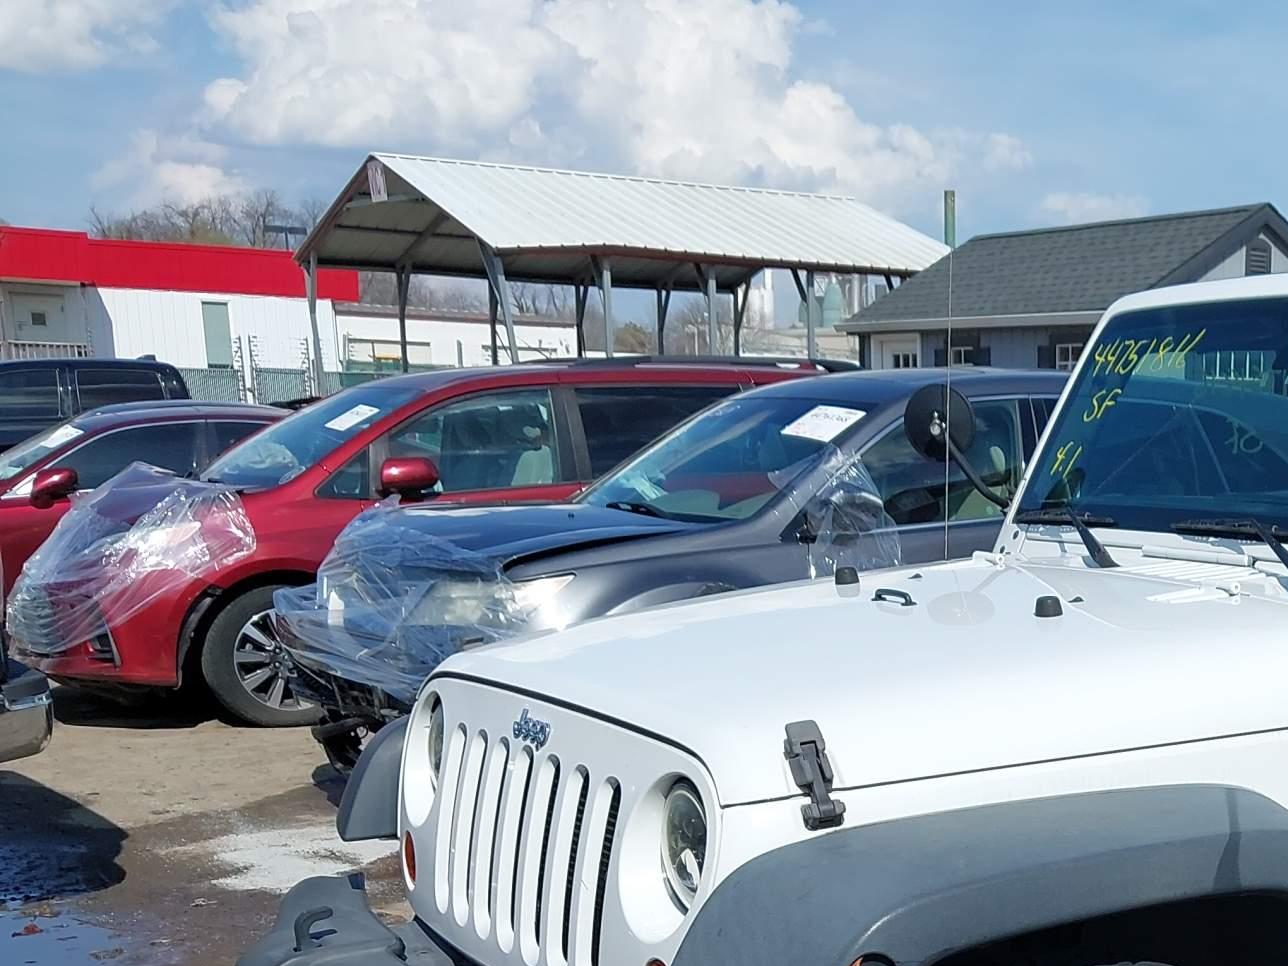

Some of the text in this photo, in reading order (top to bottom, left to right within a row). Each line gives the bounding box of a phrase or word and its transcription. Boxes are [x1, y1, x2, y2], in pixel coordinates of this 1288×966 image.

[1092, 328, 1206, 377] 44751816
[1083, 388, 1122, 423] SF
[512, 708, 551, 752] Jeep
